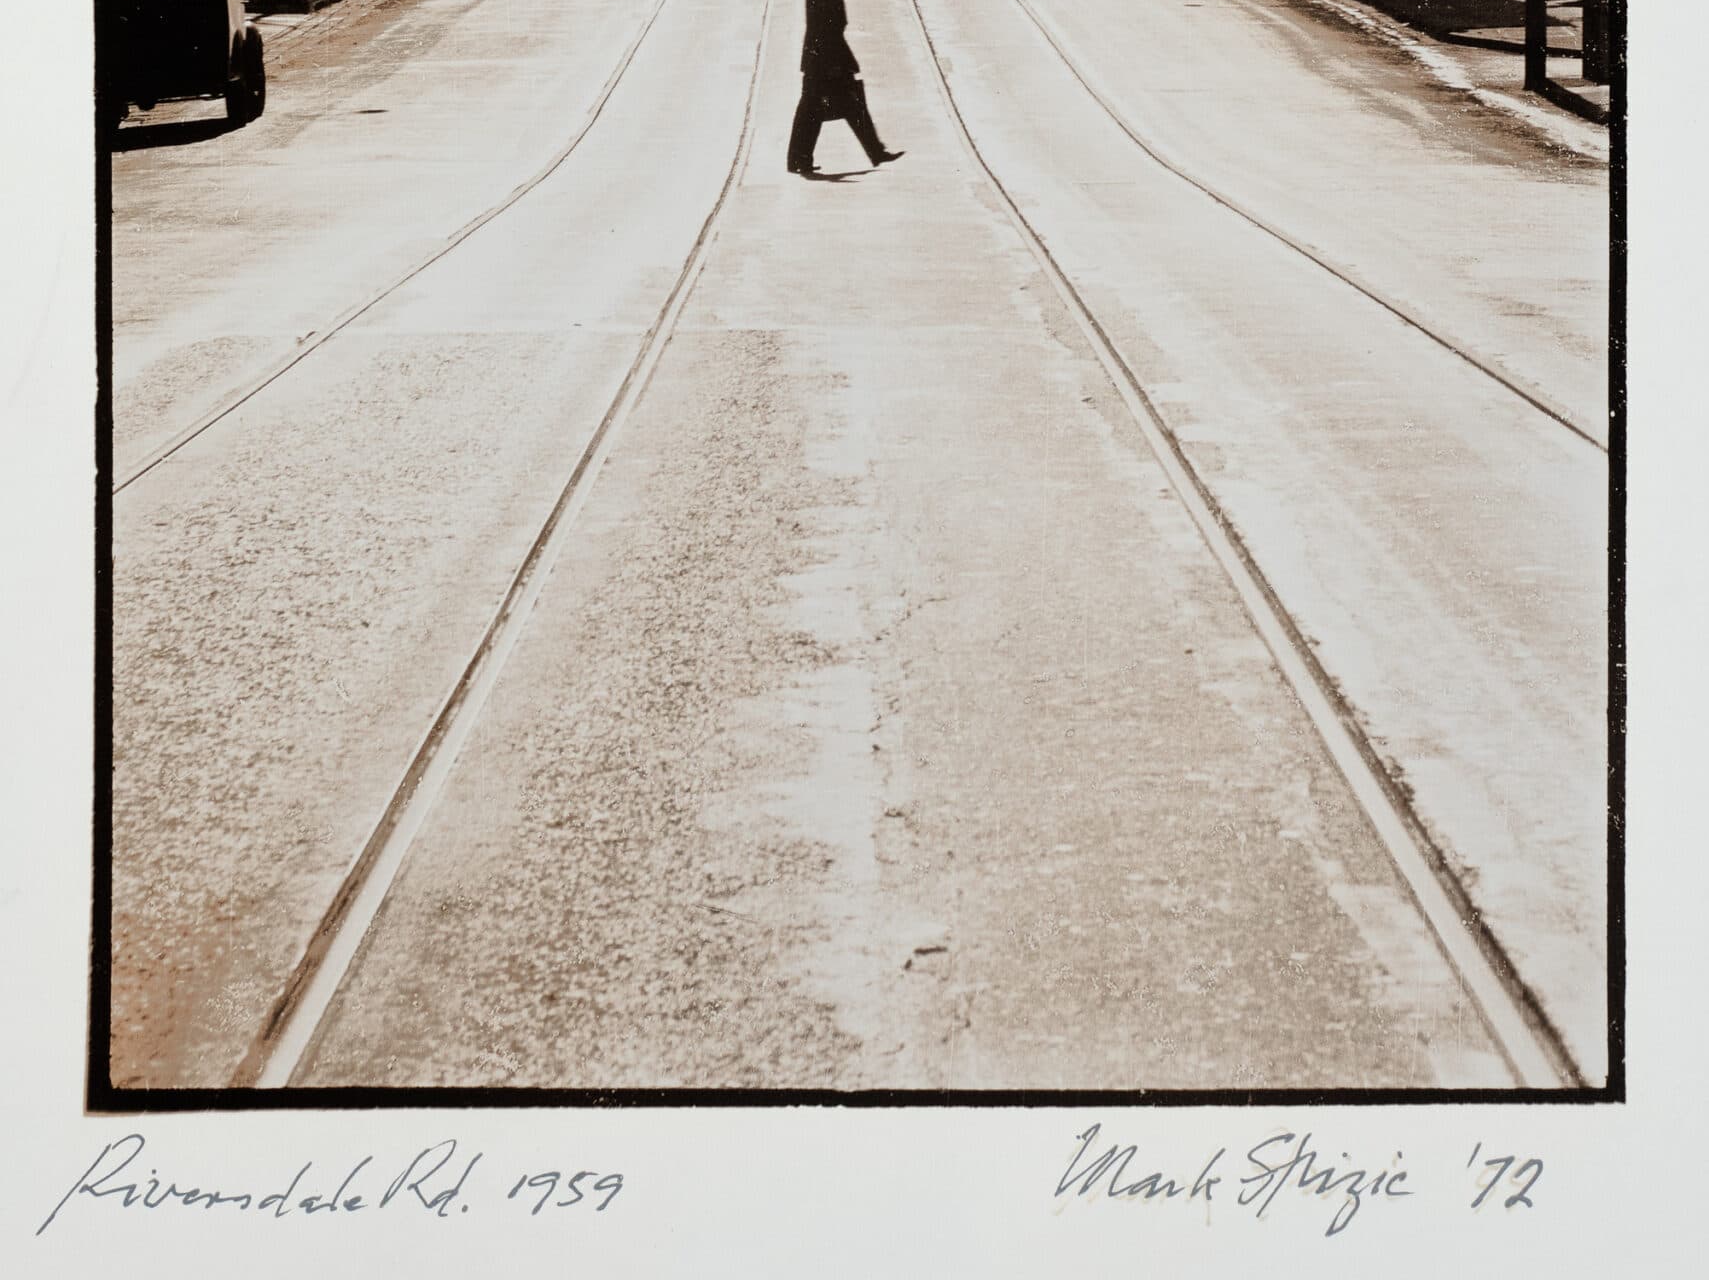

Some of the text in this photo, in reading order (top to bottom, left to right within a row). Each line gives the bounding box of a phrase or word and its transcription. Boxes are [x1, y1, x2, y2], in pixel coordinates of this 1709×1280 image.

[36, 1134, 623, 1236] Riversdale Rd. 1959
[1055, 1123, 1225, 1200] Mark
[1468, 1142, 1543, 1208] '72
